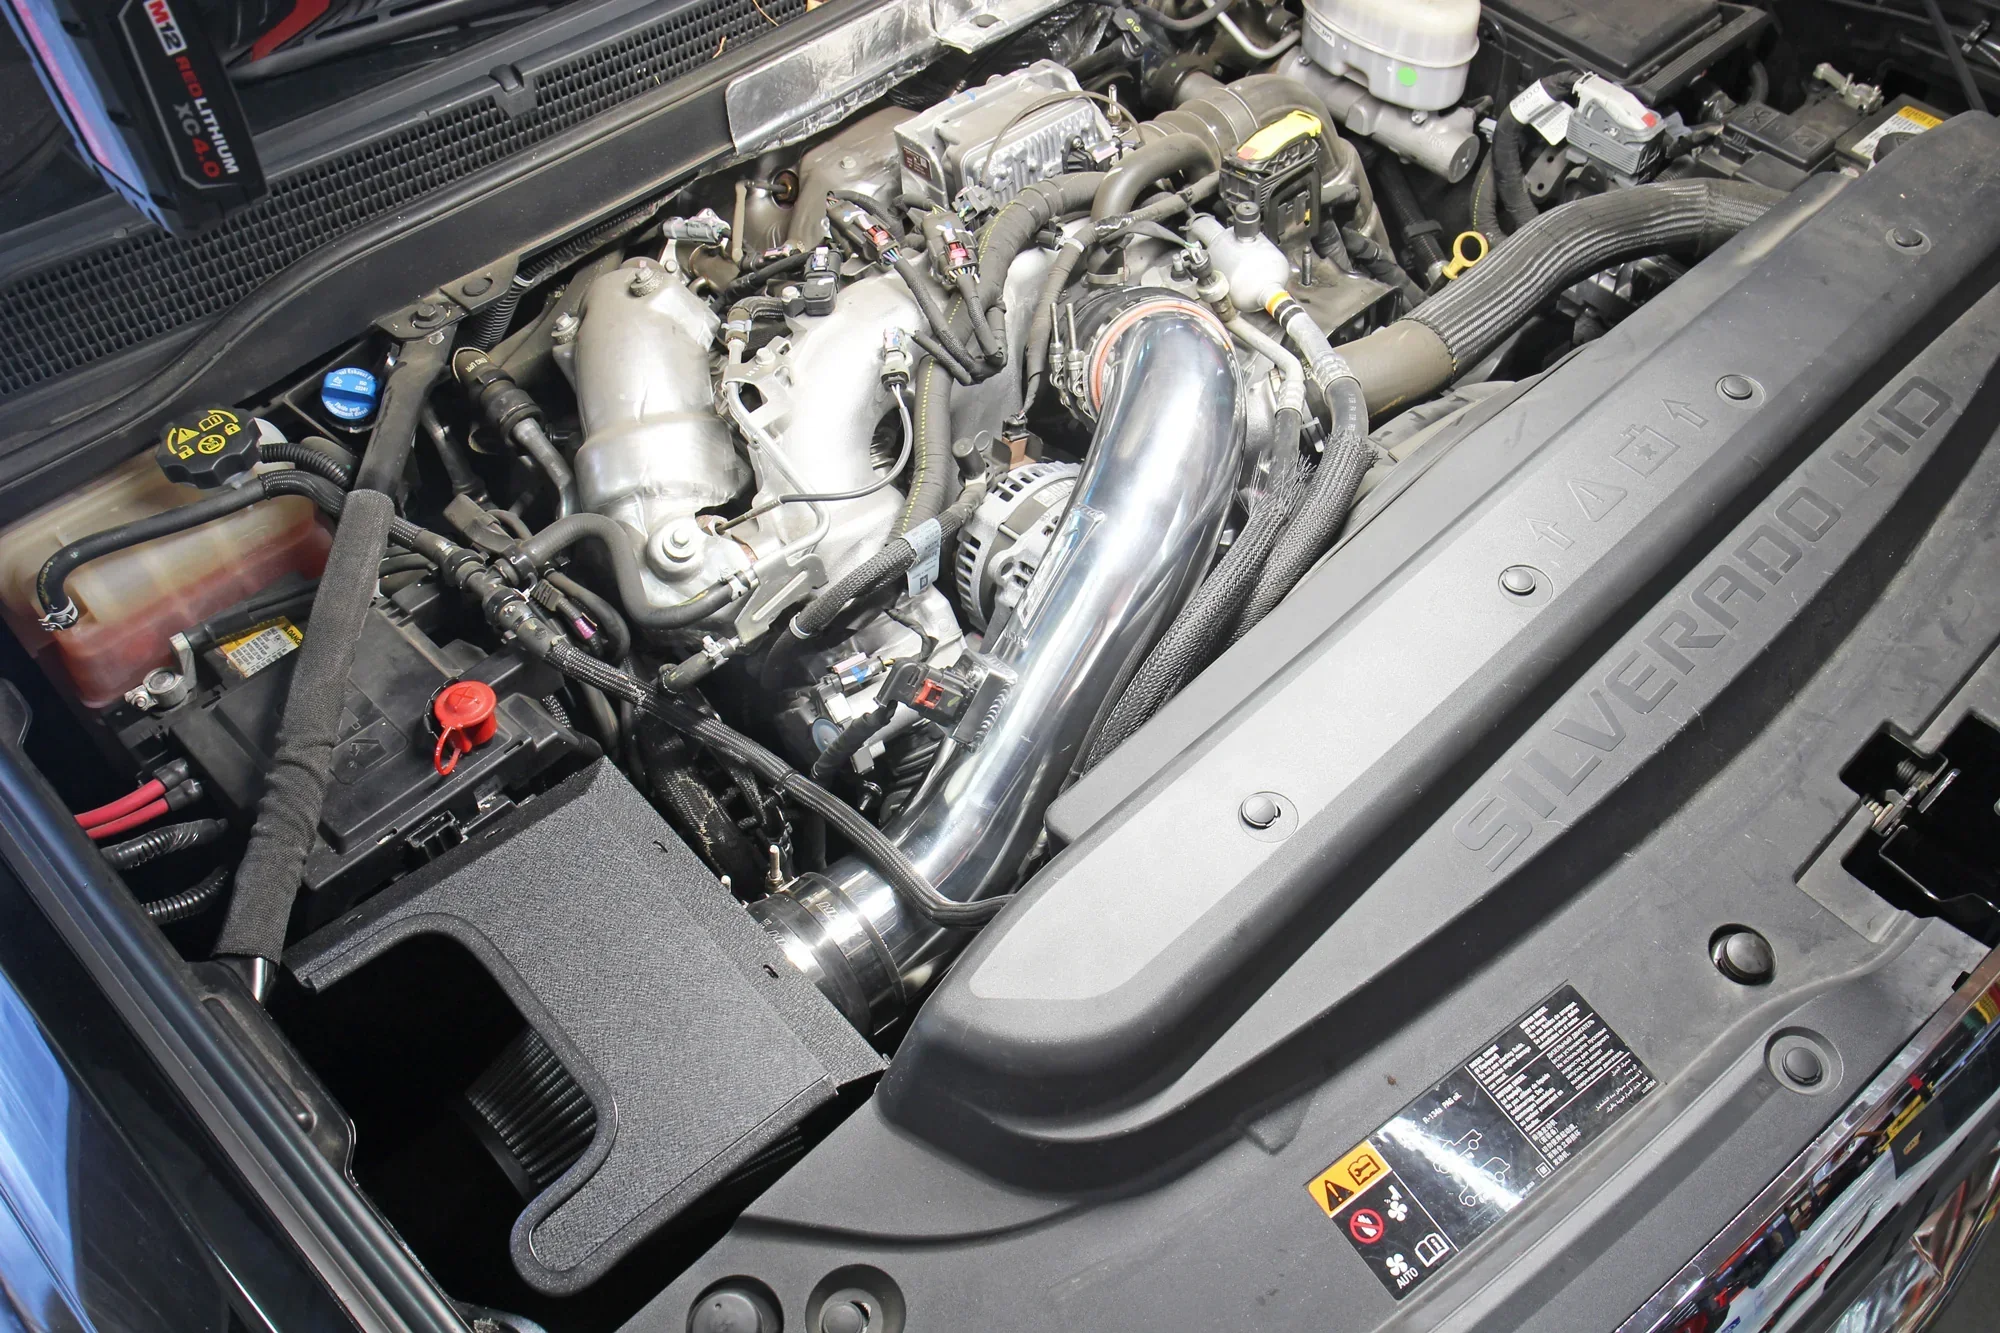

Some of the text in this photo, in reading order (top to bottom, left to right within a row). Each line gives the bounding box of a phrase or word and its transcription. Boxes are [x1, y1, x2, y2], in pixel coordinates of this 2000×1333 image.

[148, 0, 240, 174] M12 REDLITHIUM
[173, 102, 220, 178] XC 4.0
[1452, 375, 1953, 872] SILVERADO HD
[1441, 1096, 1454, 1109] PAG
[1396, 1267, 1419, 1289] AUTO
